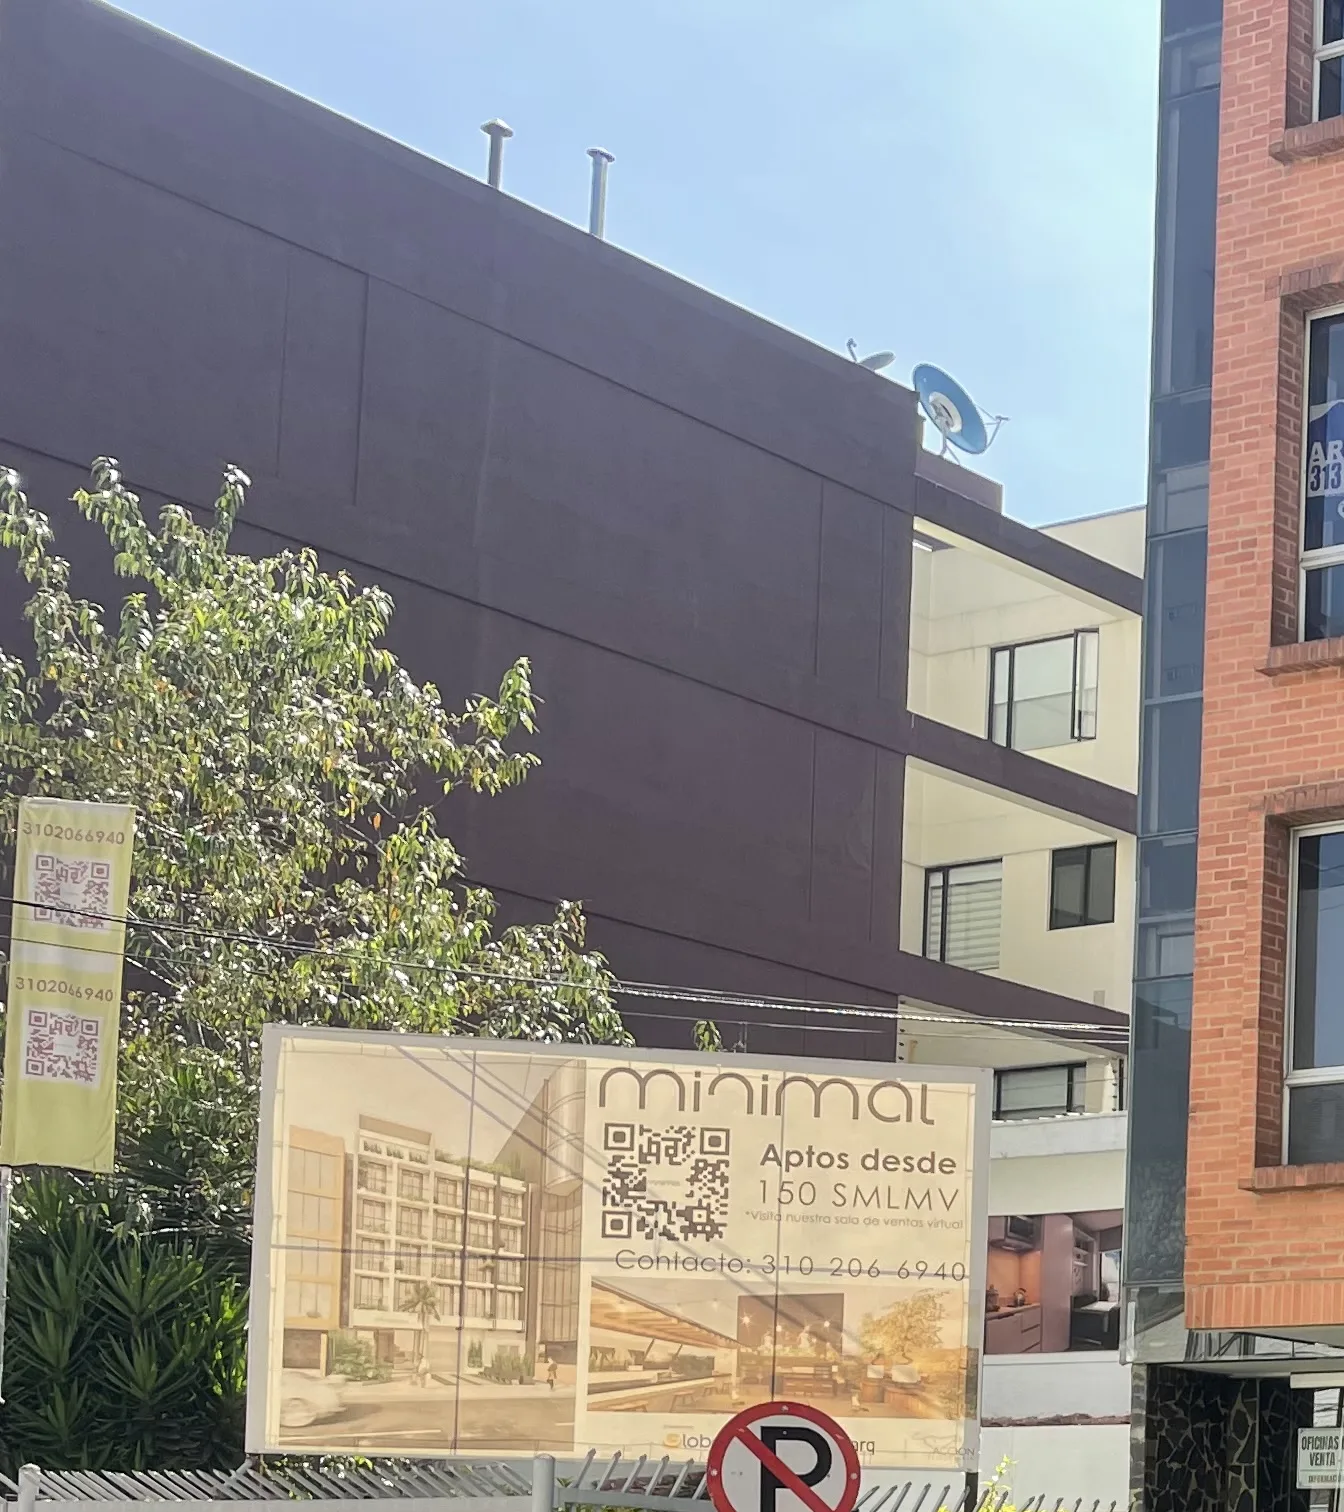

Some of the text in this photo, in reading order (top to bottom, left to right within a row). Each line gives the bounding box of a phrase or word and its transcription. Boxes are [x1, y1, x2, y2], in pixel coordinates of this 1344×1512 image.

[1309, 461, 1341, 491] 313
[23, 821, 126, 845] 3102066940
[15, 976, 114, 1003] 3102066940
[599, 1066, 935, 1125] minimal
[760, 1143, 957, 1174] Aptos desde
[759, 1180, 959, 1211] 150 SMLMV
[785, 1212, 831, 1225] nuestra
[834, 1214, 860, 1226] sala
[863, 1216, 880, 1226] de
[883, 1217, 924, 1228] ventas
[927, 1219, 964, 1230] virtual
[614, 1249, 966, 1282] Contacto: 310 206 6940
[1310, 1452, 1336, 1467] VENTA
